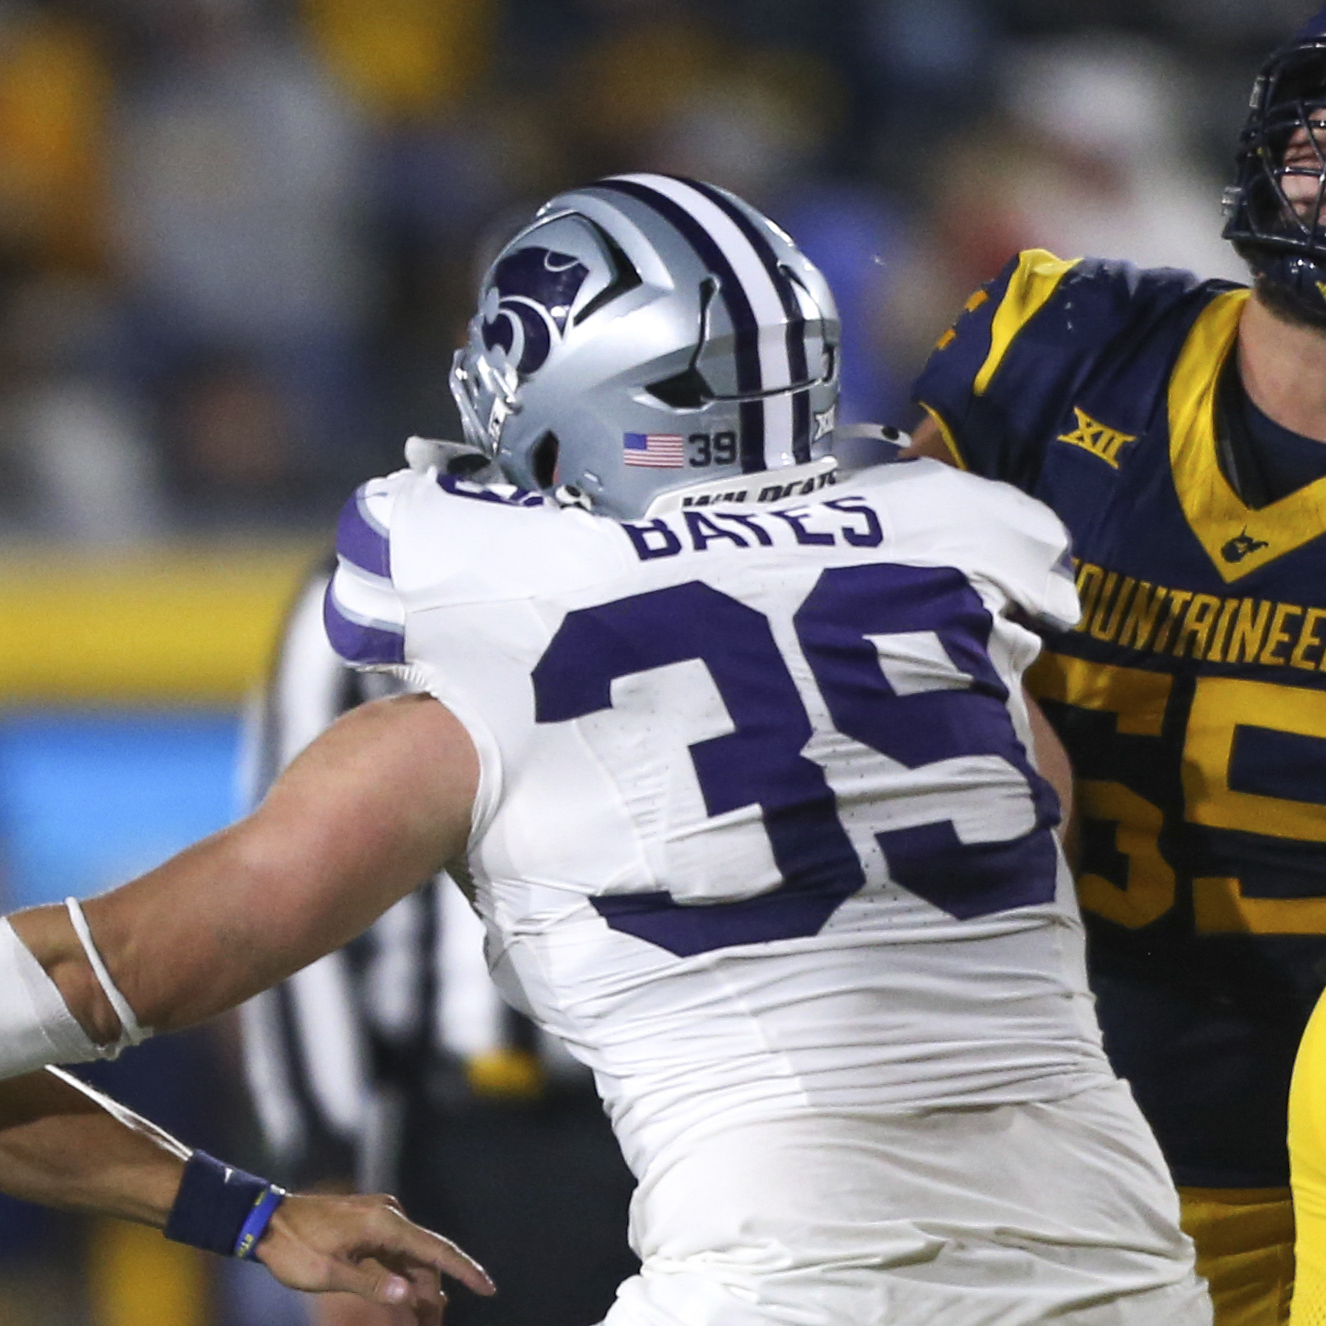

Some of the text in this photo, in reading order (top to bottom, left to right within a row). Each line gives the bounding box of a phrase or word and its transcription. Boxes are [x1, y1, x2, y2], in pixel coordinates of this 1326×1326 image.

[688, 431, 737, 468] 39
[621, 495, 884, 561] BATES
[1070, 556, 1326, 673] OUNTAINEE
[531, 562, 1062, 958] 39
